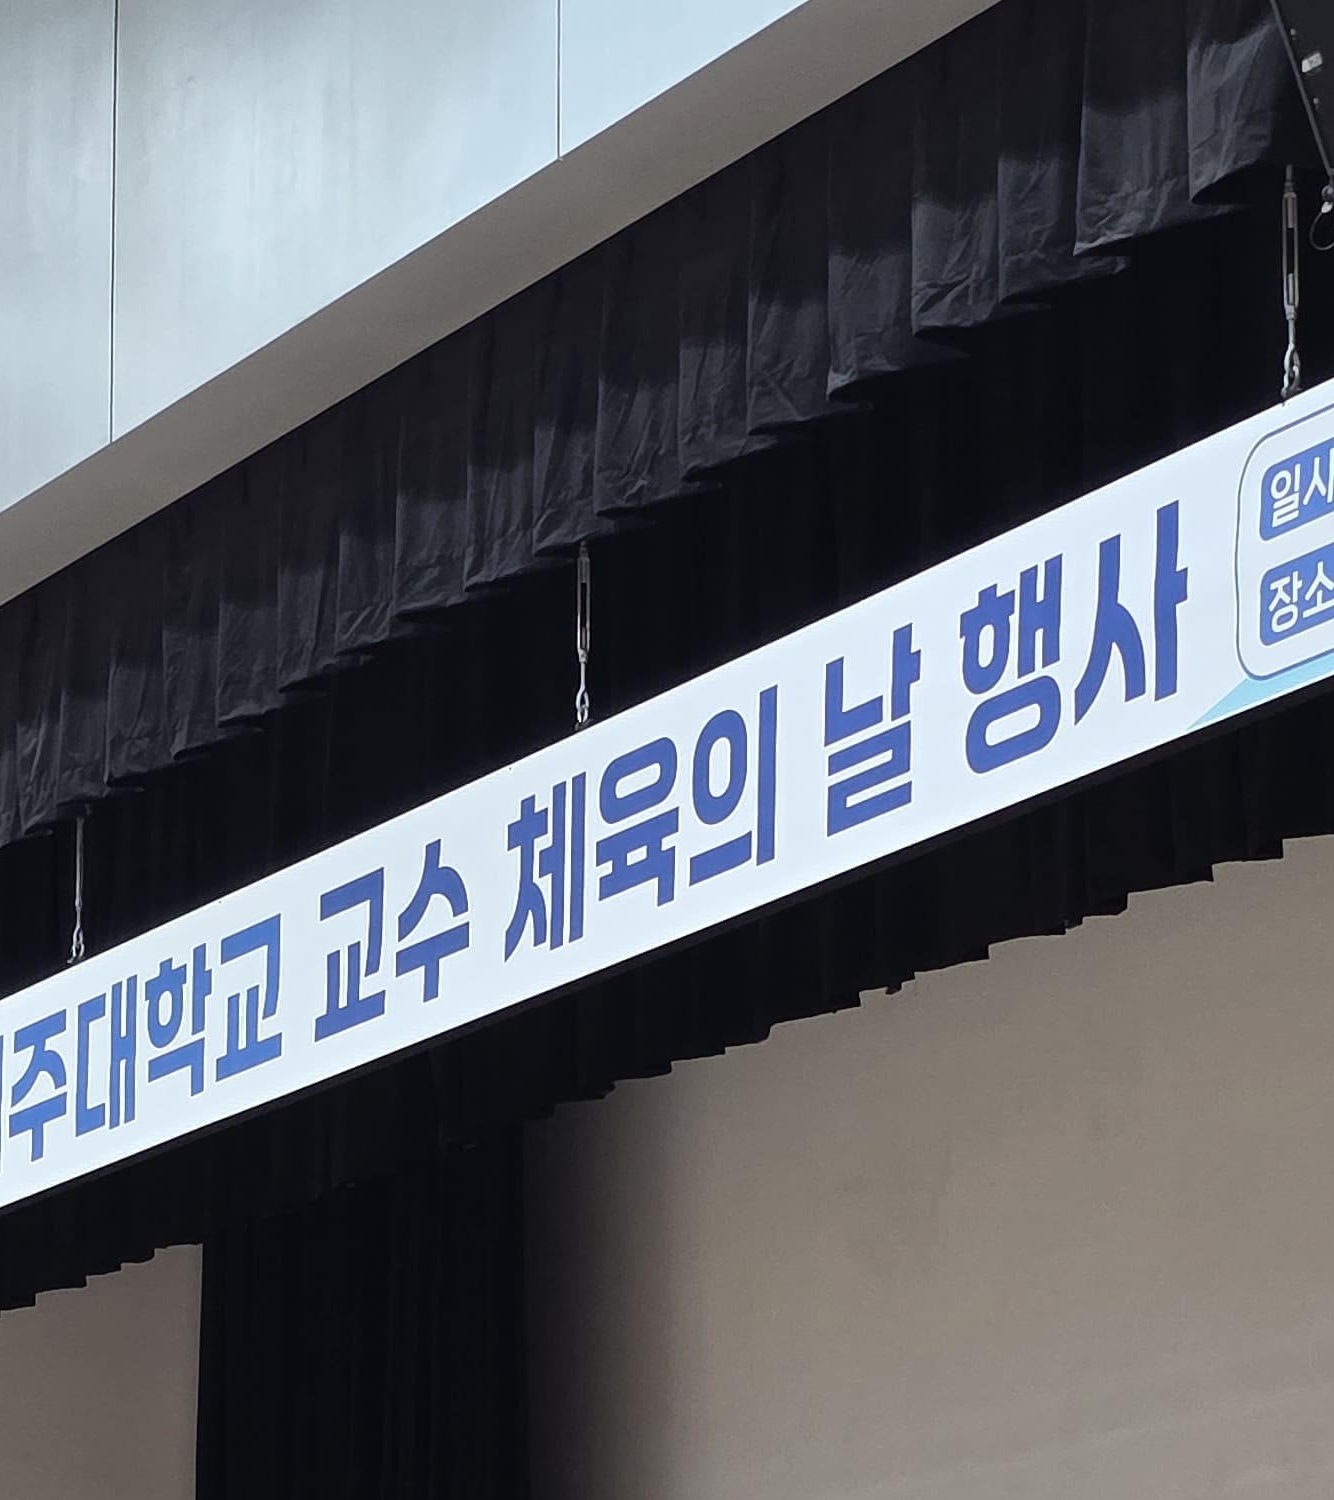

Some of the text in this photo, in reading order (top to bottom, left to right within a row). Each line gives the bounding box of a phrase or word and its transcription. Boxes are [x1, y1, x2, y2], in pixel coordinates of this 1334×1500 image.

[314, 838, 469, 1043] 교수
[504, 684, 779, 963] 체육의
[823, 623, 921, 837] 날
[959, 500, 1188, 775] 행사
